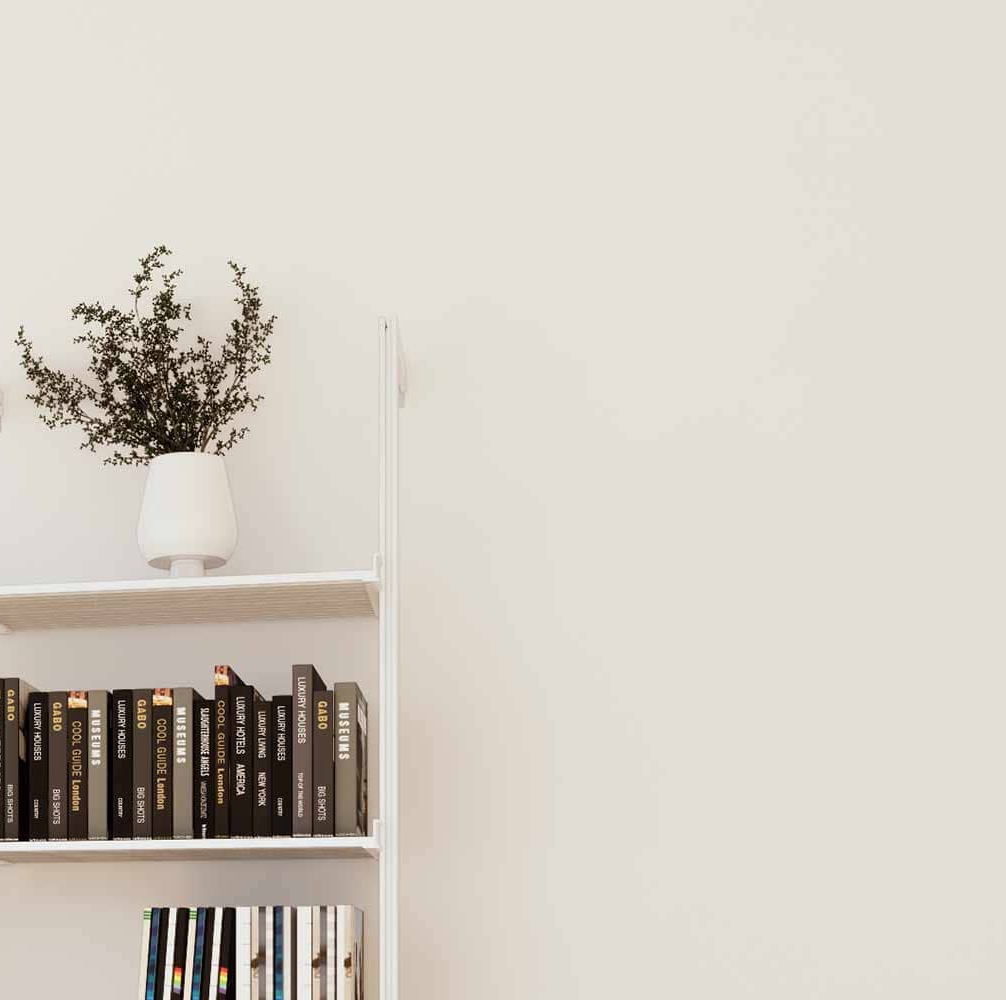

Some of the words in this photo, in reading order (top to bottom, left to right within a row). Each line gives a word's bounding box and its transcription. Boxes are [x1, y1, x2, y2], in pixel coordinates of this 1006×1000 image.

[7, 689, 15, 721] GABO
[298, 676, 306, 708] LUXURY
[34, 702, 42, 730] LUXURY
[52, 702, 62, 732] GABO
[118, 700, 126, 728] LUXURY
[137, 699, 146, 729] GABO
[217, 700, 226, 729] COOL
[236, 696, 246, 726] LUXURY
[258, 711, 266, 737] LUXURY
[278, 706, 286, 732] LUXURY
[318, 701, 328, 730] GABO
[72, 720, 82, 746] COOL
[91, 709, 101, 766] MUSEUMS
[156, 718, 166, 744] COOL
[176, 706, 186, 764] MUSEUMS
[236, 726, 246, 755] HOTELS
[298, 710, 306, 744] HOUSES
[338, 702, 350, 760] MUSEUMS
[34, 732, 42, 761] HOUSES
[118, 730, 126, 760] HOUSES
[217, 732, 226, 764] GUIDE
[258, 738, 266, 759] LIVING
[278, 733, 286, 761] HOUSES
[72, 748, 82, 776] GUIDE
[156, 746, 166, 775] GUIDE
[200, 756, 210, 777] ANGELS
[52, 788, 60, 800] BIG
[136, 786, 144, 799] BIG
[156, 778, 166, 810] London
[217, 768, 225, 804] London
[236, 763, 246, 796] AMERICA
[258, 772, 266, 788] NEW
[318, 786, 326, 798] BIG
[72, 780, 81, 812] London
[258, 788, 266, 807] YORK
[318, 799, 326, 821] SHOTS
[52, 802, 60, 825] SHOTS
[136, 800, 144, 824] SHOTS
